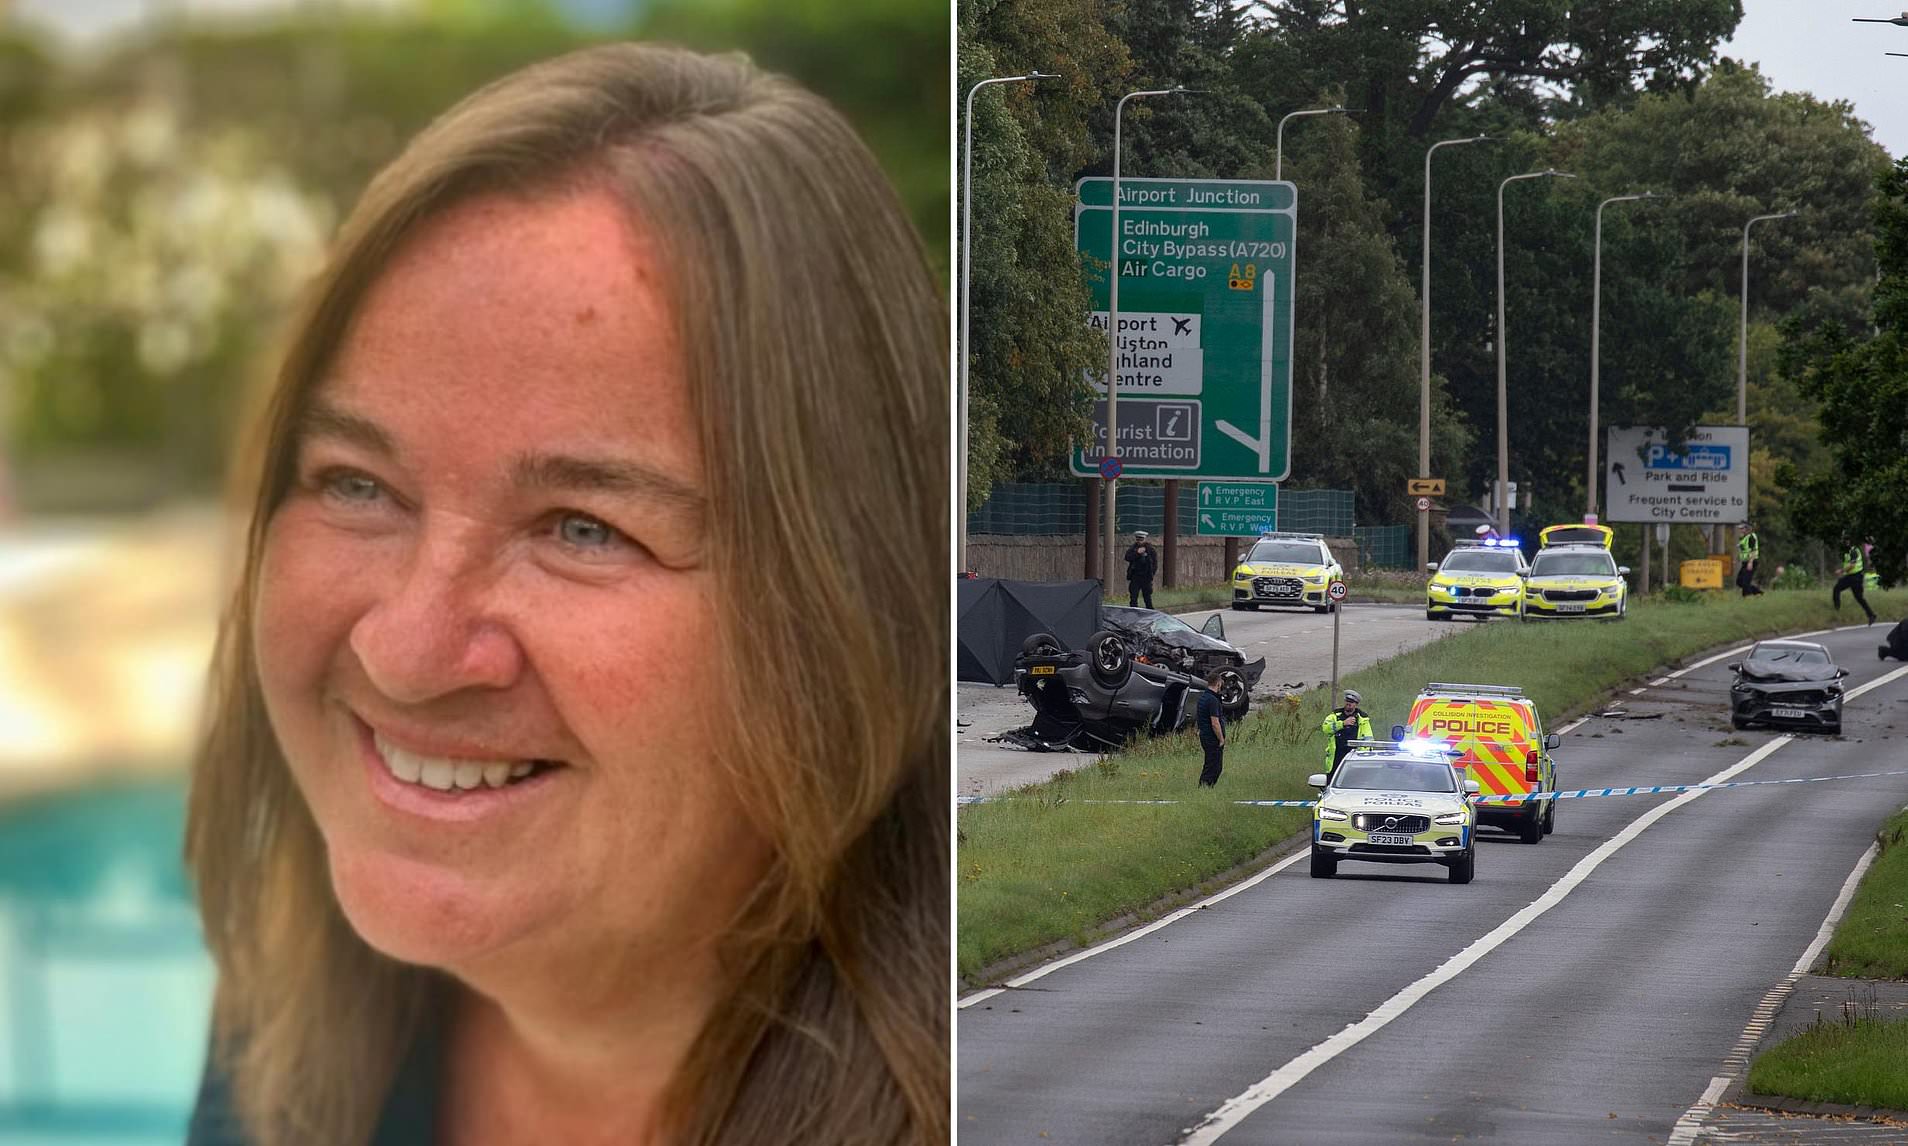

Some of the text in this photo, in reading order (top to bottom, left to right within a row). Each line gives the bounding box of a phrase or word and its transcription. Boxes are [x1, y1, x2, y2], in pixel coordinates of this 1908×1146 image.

[1117, 187, 1260, 204] Airport Junction
[1123, 220, 1209, 239] Edinburgh
[1123, 240, 1286, 259] City Bypass (A720)
[1122, 261, 1207, 280] Air Cargo
[1091, 315, 1157, 333] Aiport
[1116, 335, 1168, 352] liston
[1116, 353, 1172, 370] hland
[1089, 443, 1194, 459] inormation
[1646, 471, 1728, 482] Park and Ride
[1216, 486, 1265, 496] Emergency
[1245, 496, 1265, 505] East
[1629, 494, 1744, 506] Frequent service to
[1222, 512, 1272, 523] Emergency
[1652, 507, 1720, 518] City Centre
[1250, 523, 1272, 532] West
[1331, 586, 1345, 595] 40
[1433, 719, 1511, 734] POLICE
[1371, 835, 1393, 844] SF23
